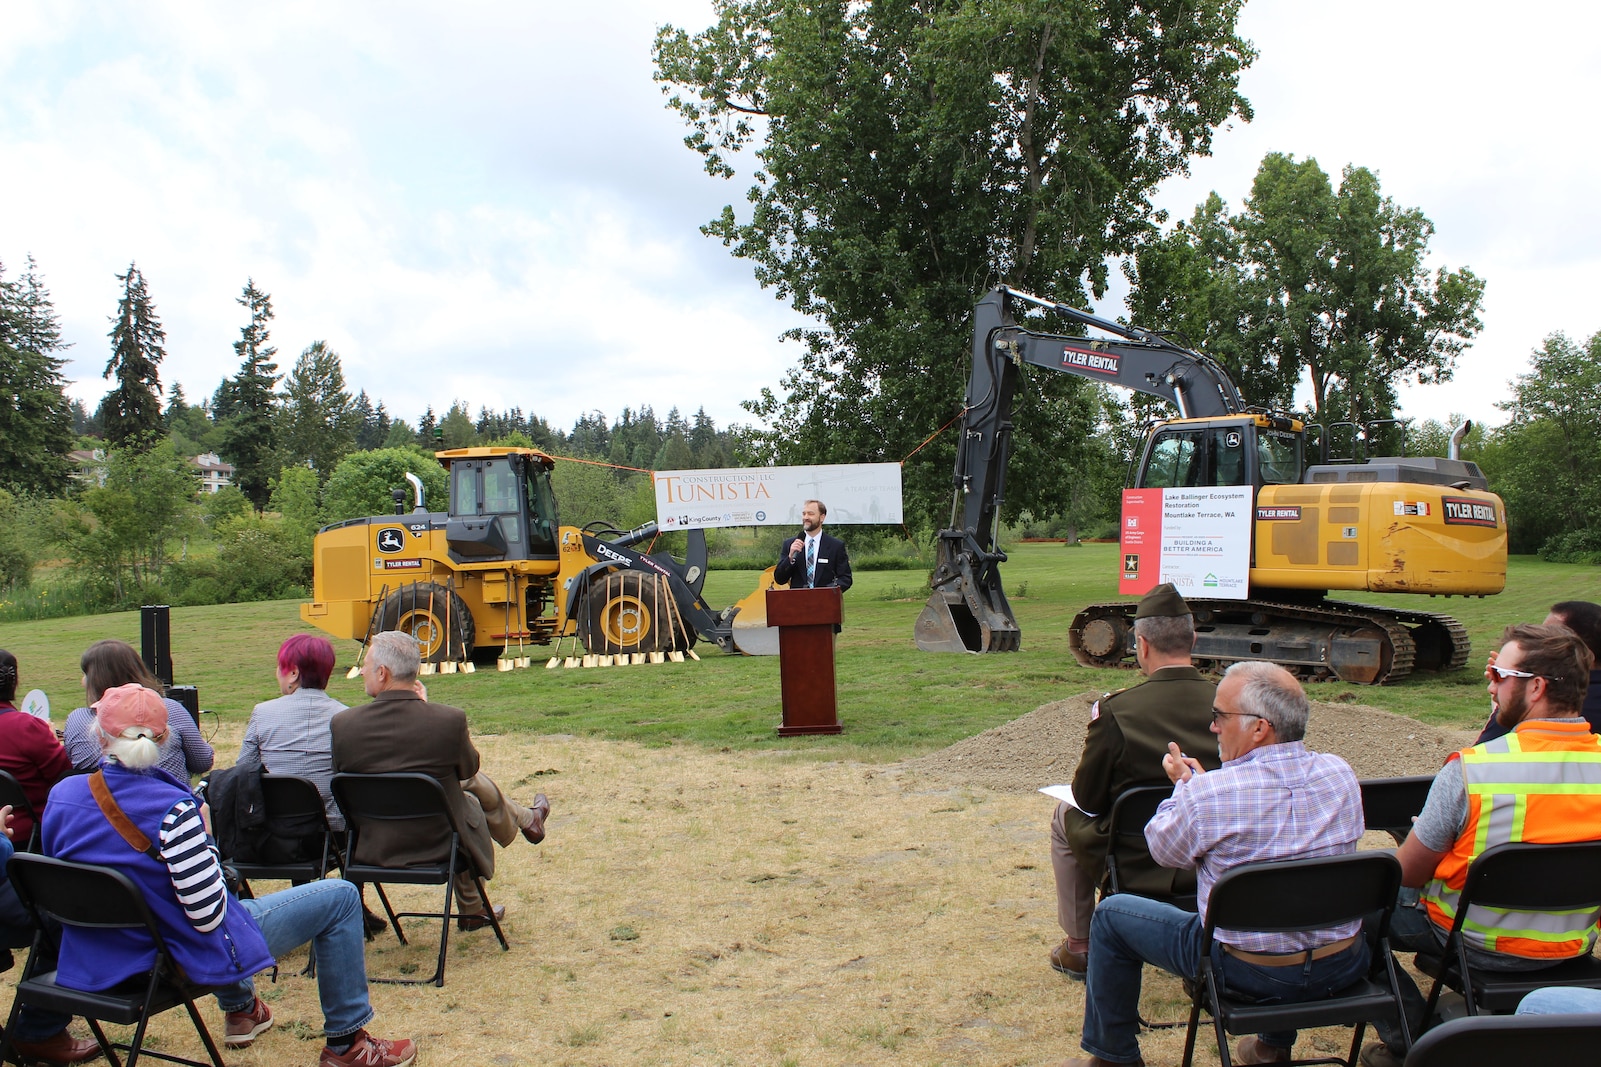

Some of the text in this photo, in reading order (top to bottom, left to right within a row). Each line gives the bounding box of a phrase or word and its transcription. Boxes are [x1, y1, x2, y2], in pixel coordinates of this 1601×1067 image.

[1063, 350, 1118, 372] TYLER RENTAL
[1266, 429, 1295, 439] JOHN DEERE
[683, 473, 775, 484] CONSTRUCTION LLC
[657, 477, 772, 503] TUNISTA
[1210, 493, 1244, 501] Ecosystem
[1276, 509, 1299, 517] RENTAL
[1446, 502, 1473, 519] TYLER
[1473, 504, 1496, 521] RENTAL
[689, 515, 721, 524] King County
[639, 555, 671, 578] TYLER RENTAL
